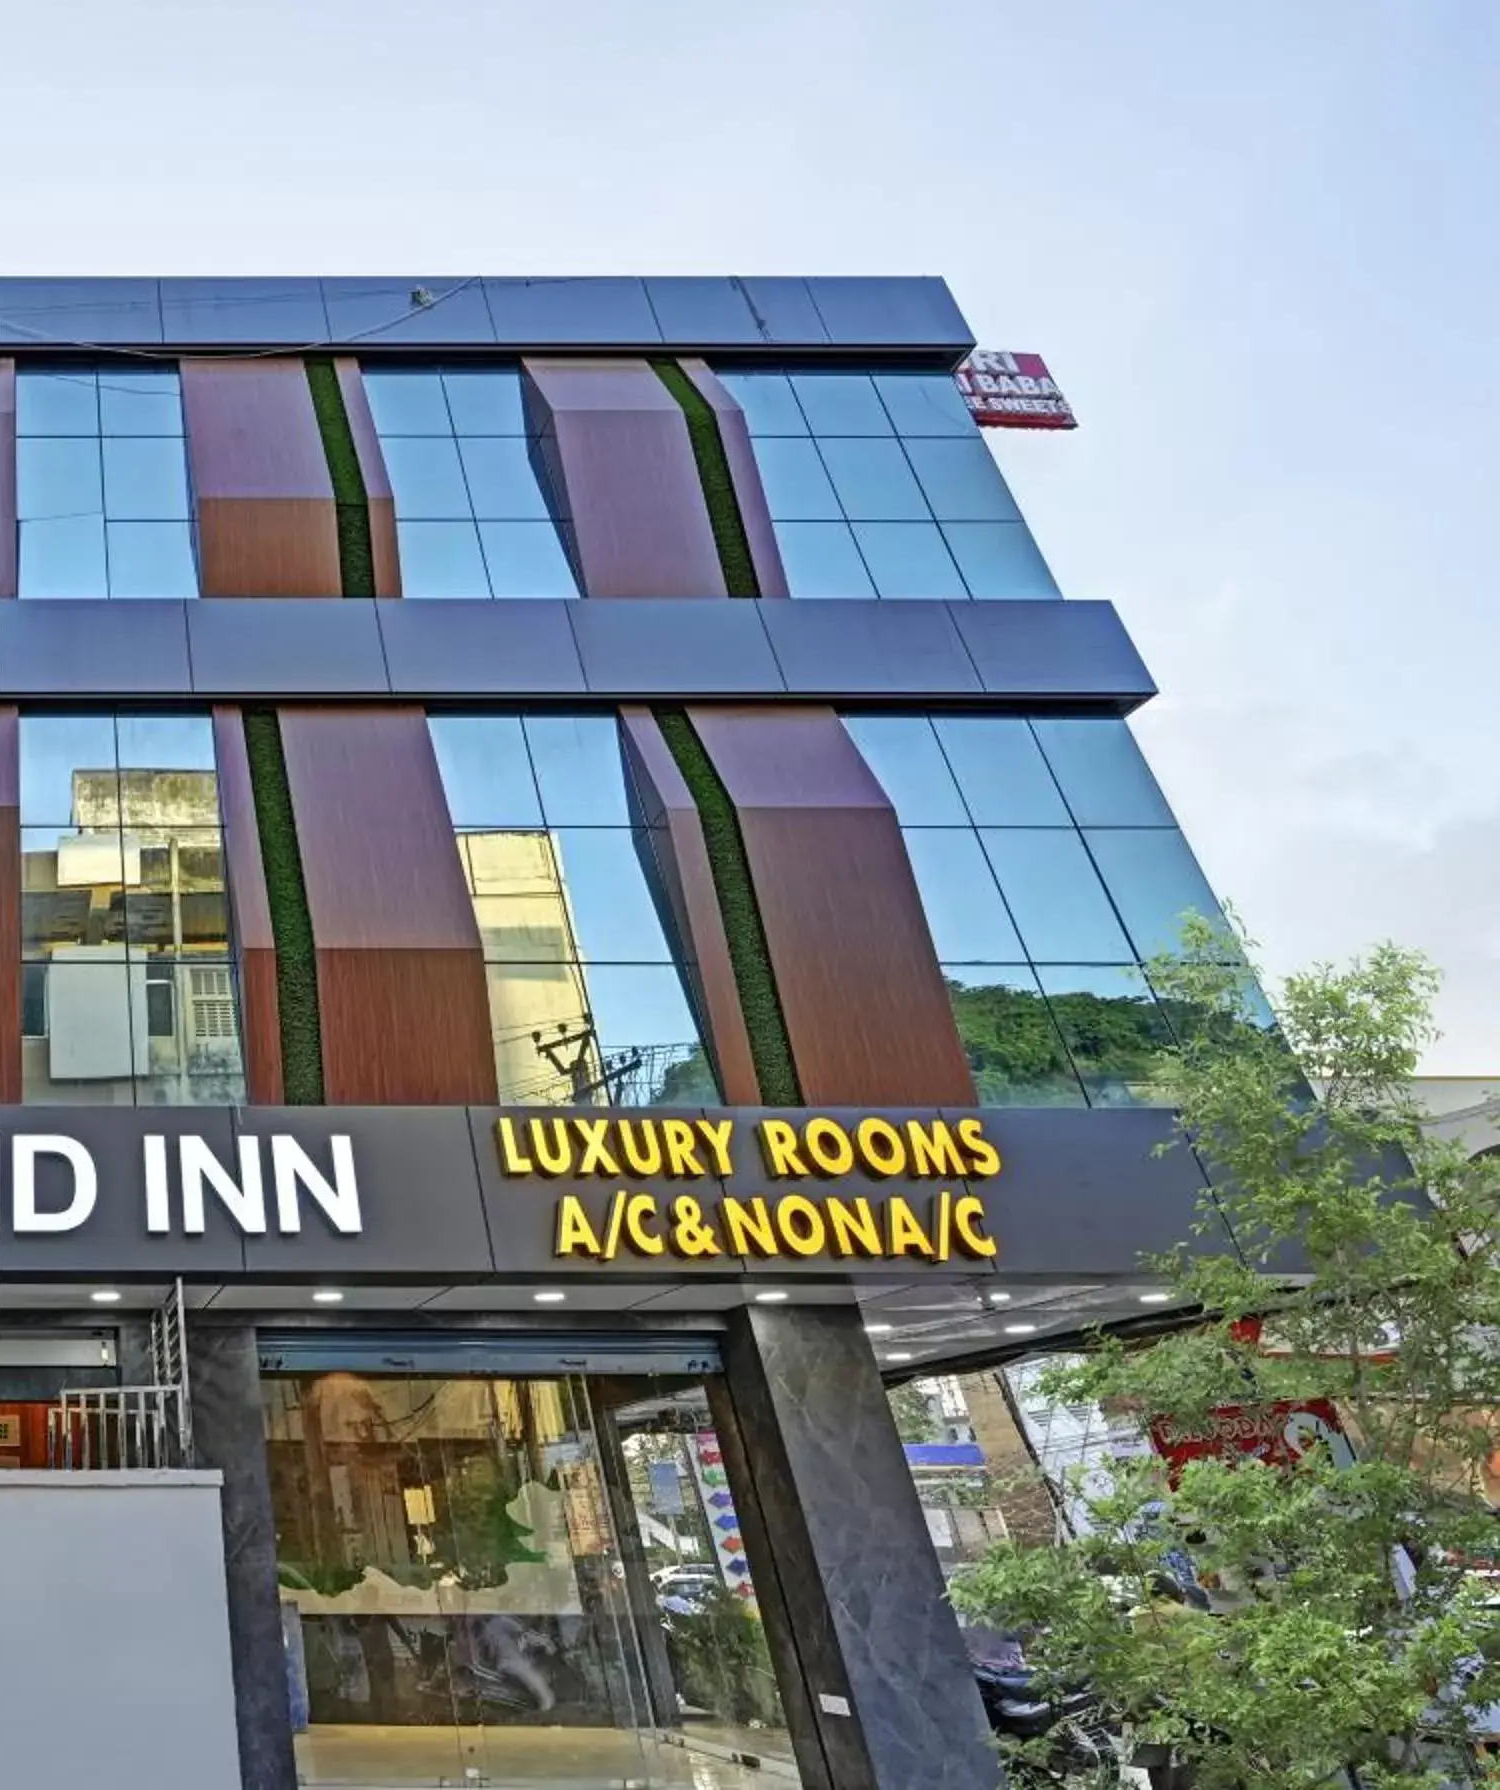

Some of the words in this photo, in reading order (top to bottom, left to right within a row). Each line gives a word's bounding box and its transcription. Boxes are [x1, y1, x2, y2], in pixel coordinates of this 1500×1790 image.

[958, 351, 1020, 373] RI
[975, 374, 1063, 398] BABA
[500, 1118, 733, 1177] LUXURY
[756, 1117, 1001, 1178] ROOMS
[142, 1134, 364, 1235] INN
